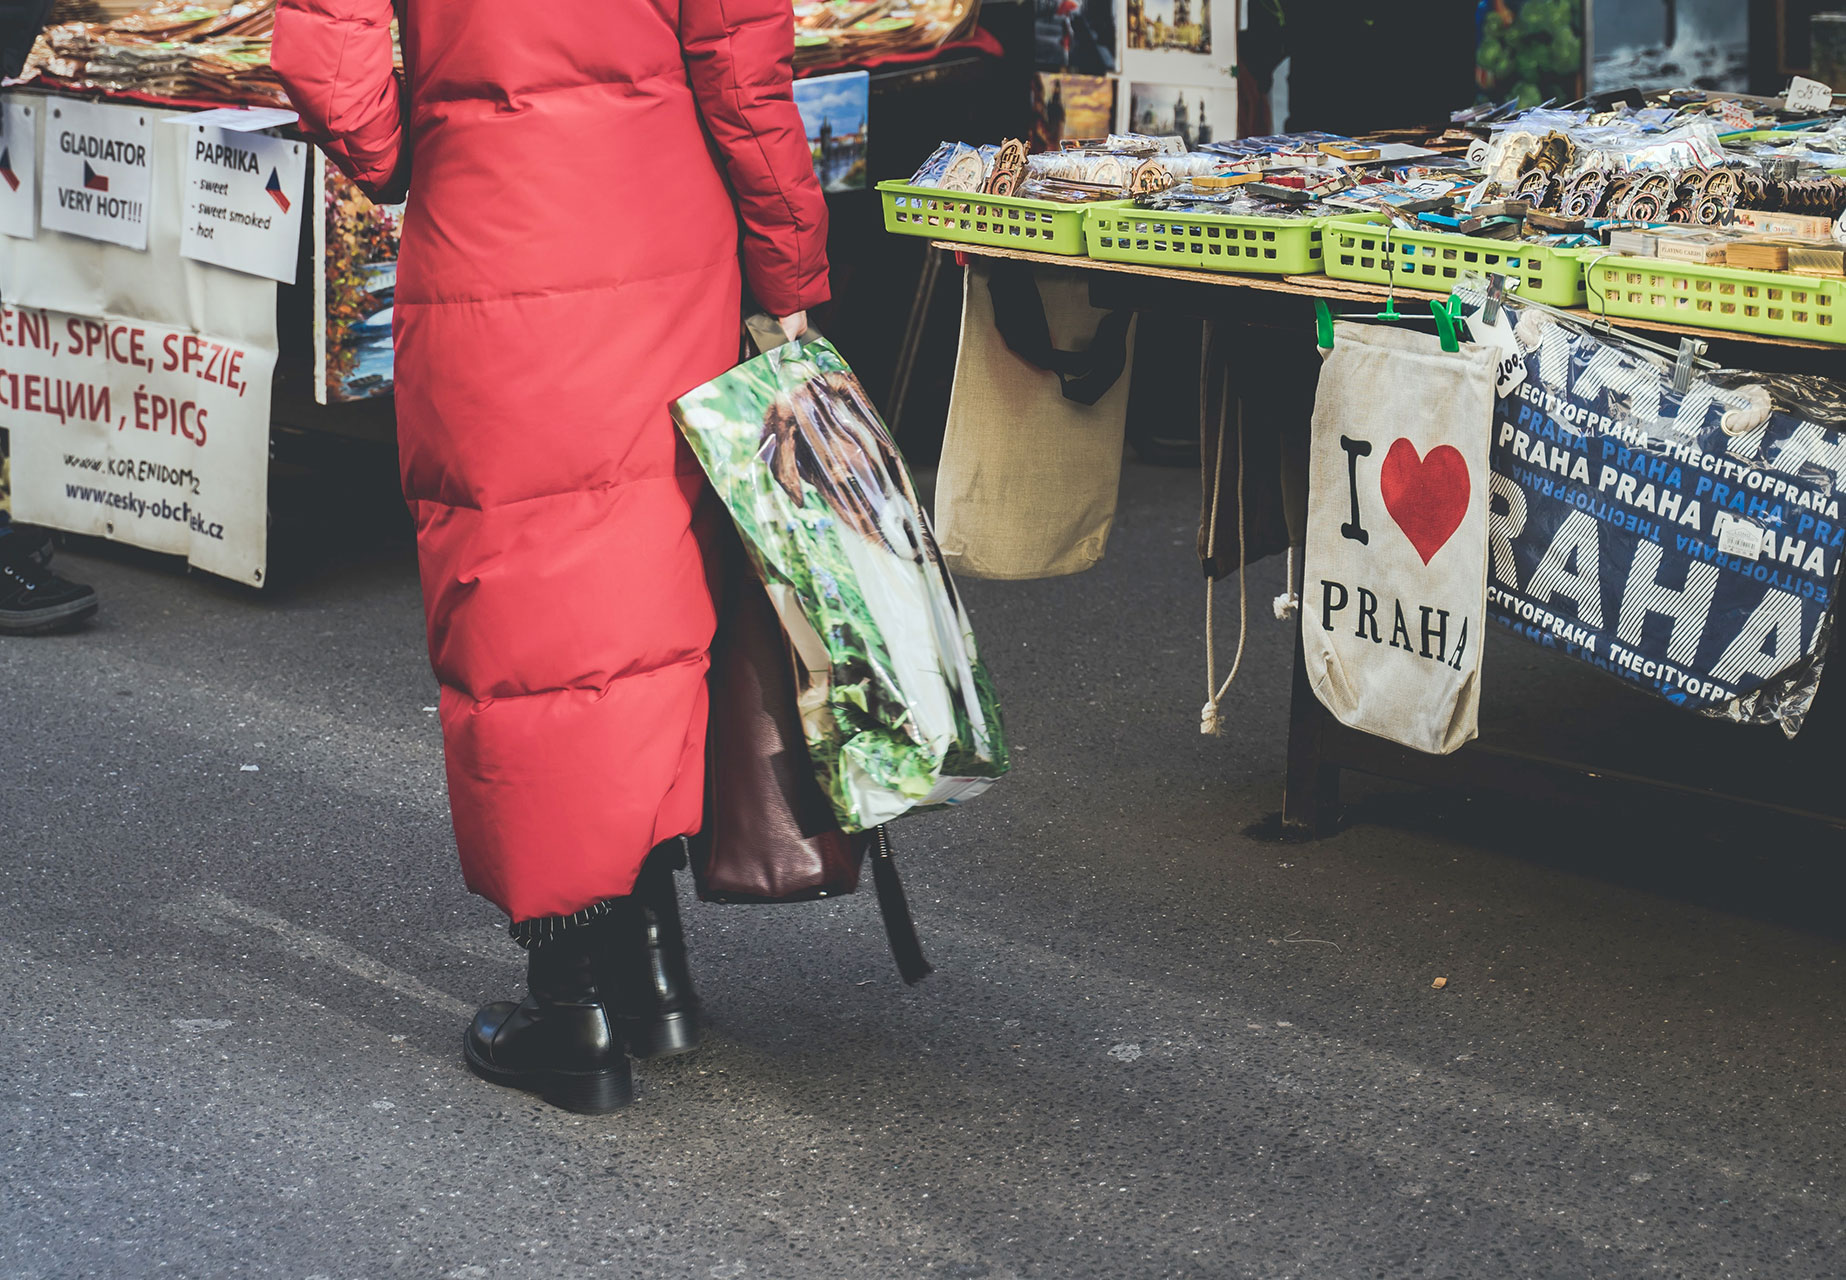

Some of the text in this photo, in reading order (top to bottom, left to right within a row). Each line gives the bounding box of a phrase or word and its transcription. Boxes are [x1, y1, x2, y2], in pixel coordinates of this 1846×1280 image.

[60, 130, 146, 167] GLADIATOR
[195, 140, 259, 175] PAPRIKA
[58, 186, 142, 223] VERY HOT!!!
[198, 203, 272, 230] sweet smoked
[200, 179, 229, 196] sweet
[196, 222, 214, 240] hot
[67, 318, 154, 374] SPICE,
[134, 384, 208, 448] ÉPICS
[1340, 434, 1372, 546] I
[1517, 404, 1589, 454] PRAHA
[1602, 440, 1682, 489] PRAHA
[1695, 475, 1783, 528] PRAHA
[1663, 438, 1839, 520] THECITYOFPRAHA
[1498, 421, 1825, 577] PRAHA PRAHA PAHA
[1676, 533, 1830, 608] ECITYOFPRAHA
[1320, 579, 1468, 671] PRAHA
